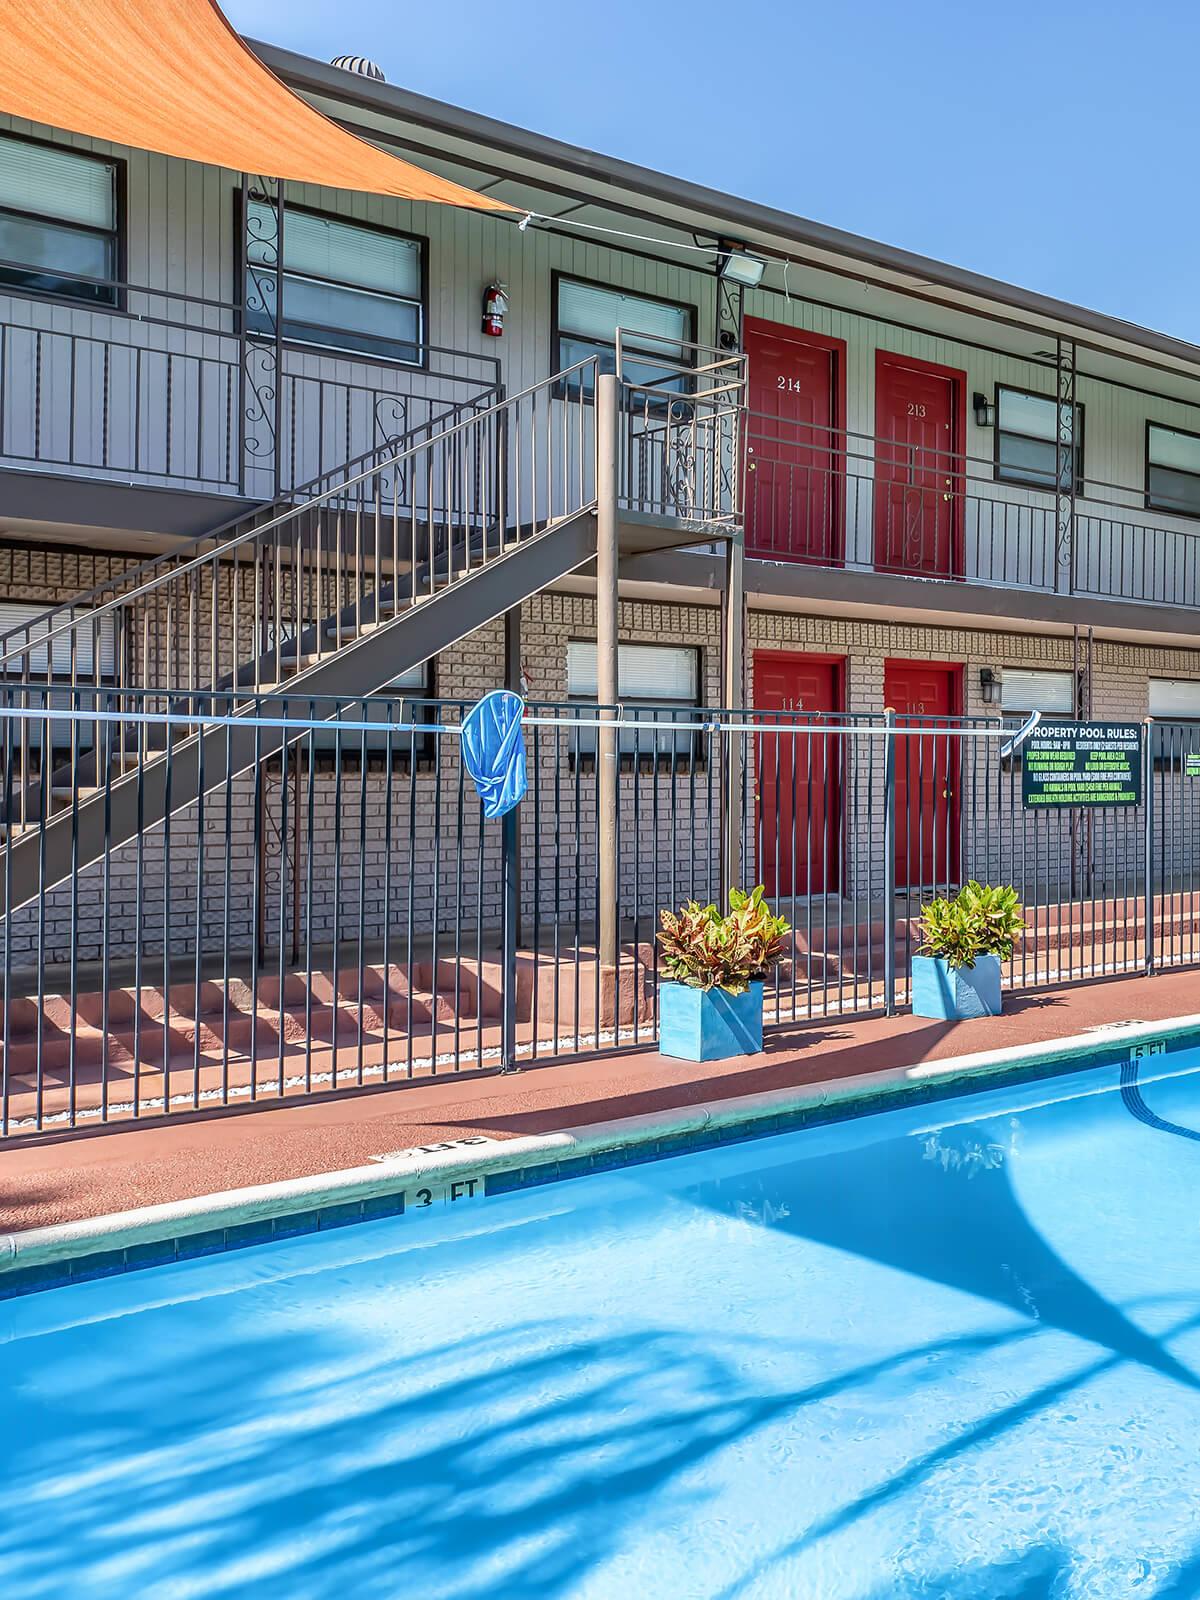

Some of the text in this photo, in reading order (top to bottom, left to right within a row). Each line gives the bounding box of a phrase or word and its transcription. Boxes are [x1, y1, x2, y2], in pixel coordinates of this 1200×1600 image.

[777, 376, 801, 393] 214
[907, 403, 926, 418] 213
[782, 698, 803, 712] 114
[906, 703, 925, 715] 113
[1028, 727, 1137, 739] PROPERTY POOL RULES:
[1135, 1042, 1164, 1058] 5 FT
[416, 1179, 478, 1208] 3 FT
